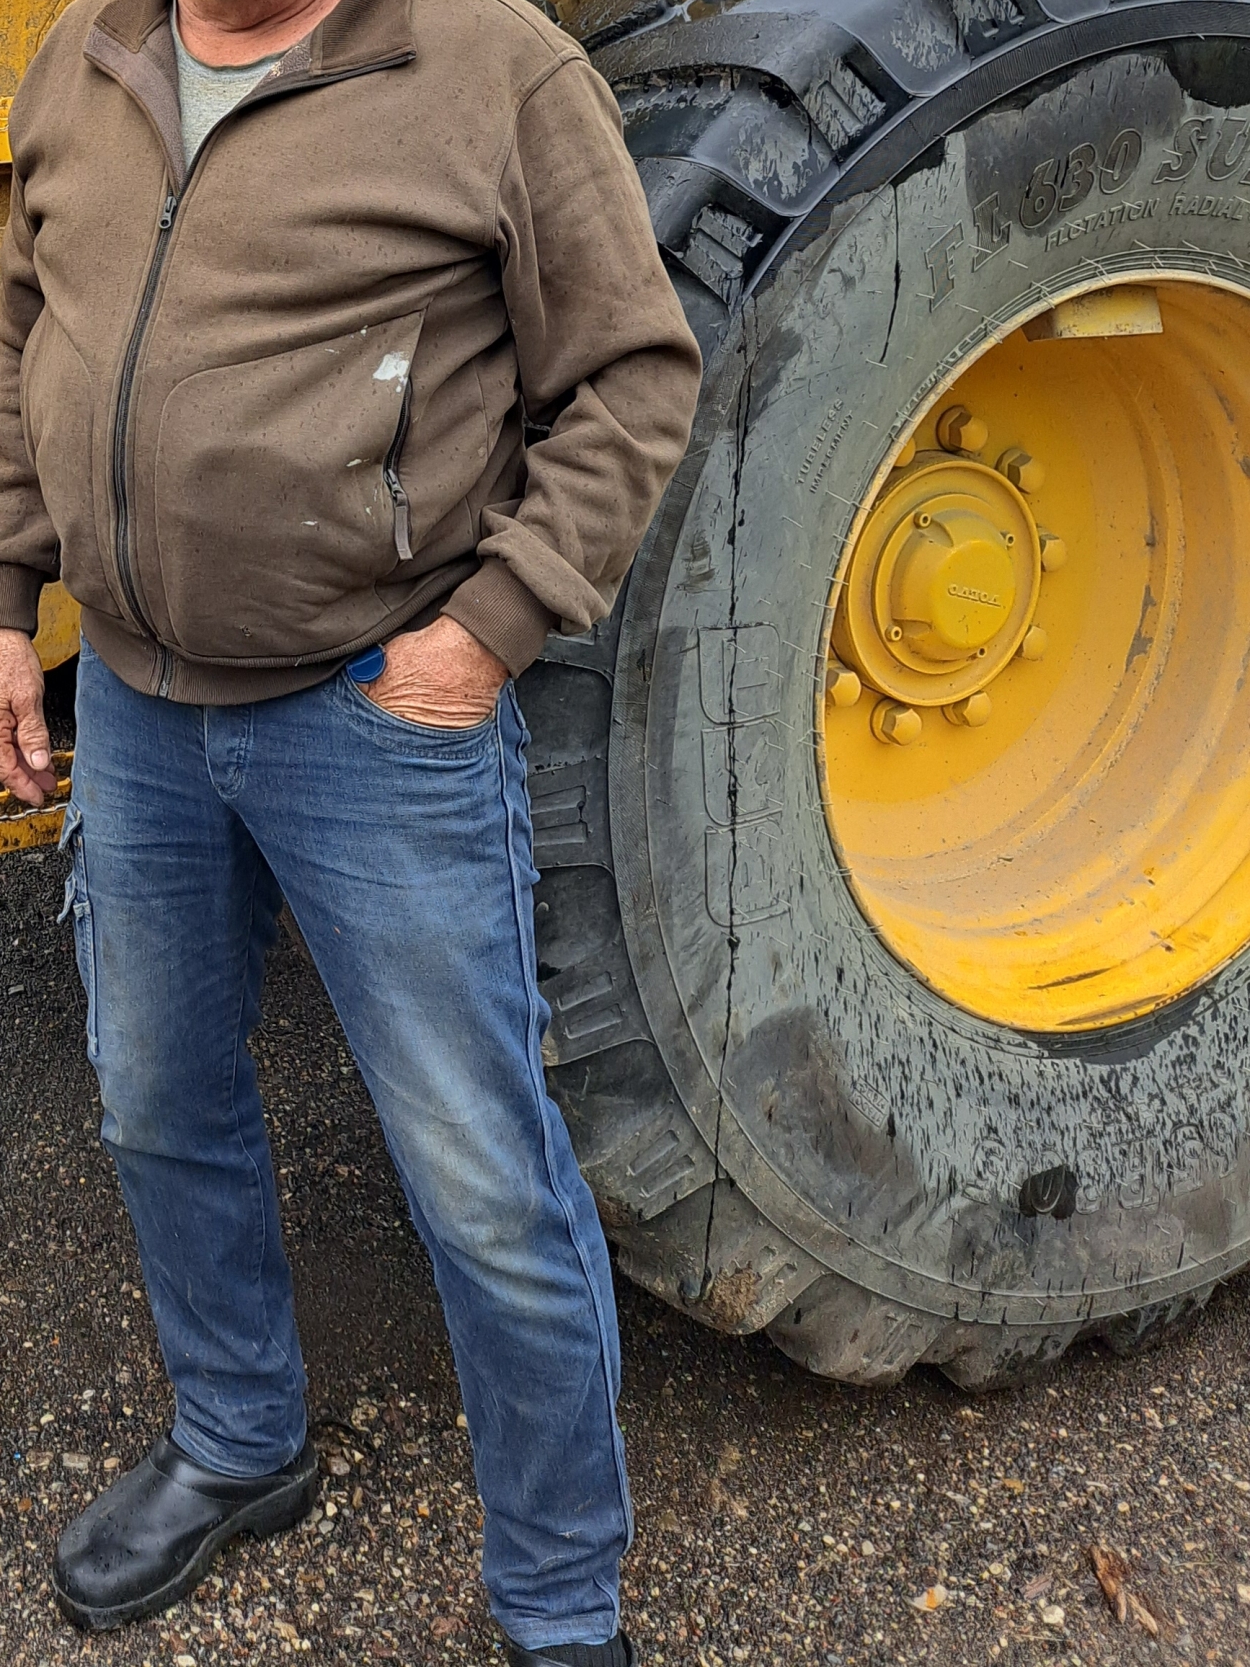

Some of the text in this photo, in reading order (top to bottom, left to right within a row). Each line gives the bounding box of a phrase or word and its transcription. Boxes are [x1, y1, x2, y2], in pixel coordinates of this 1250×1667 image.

[1019, 128, 1143, 231] 630
[1152, 116, 1250, 185] SU
[1044, 197, 1161, 253] FLOTATION
